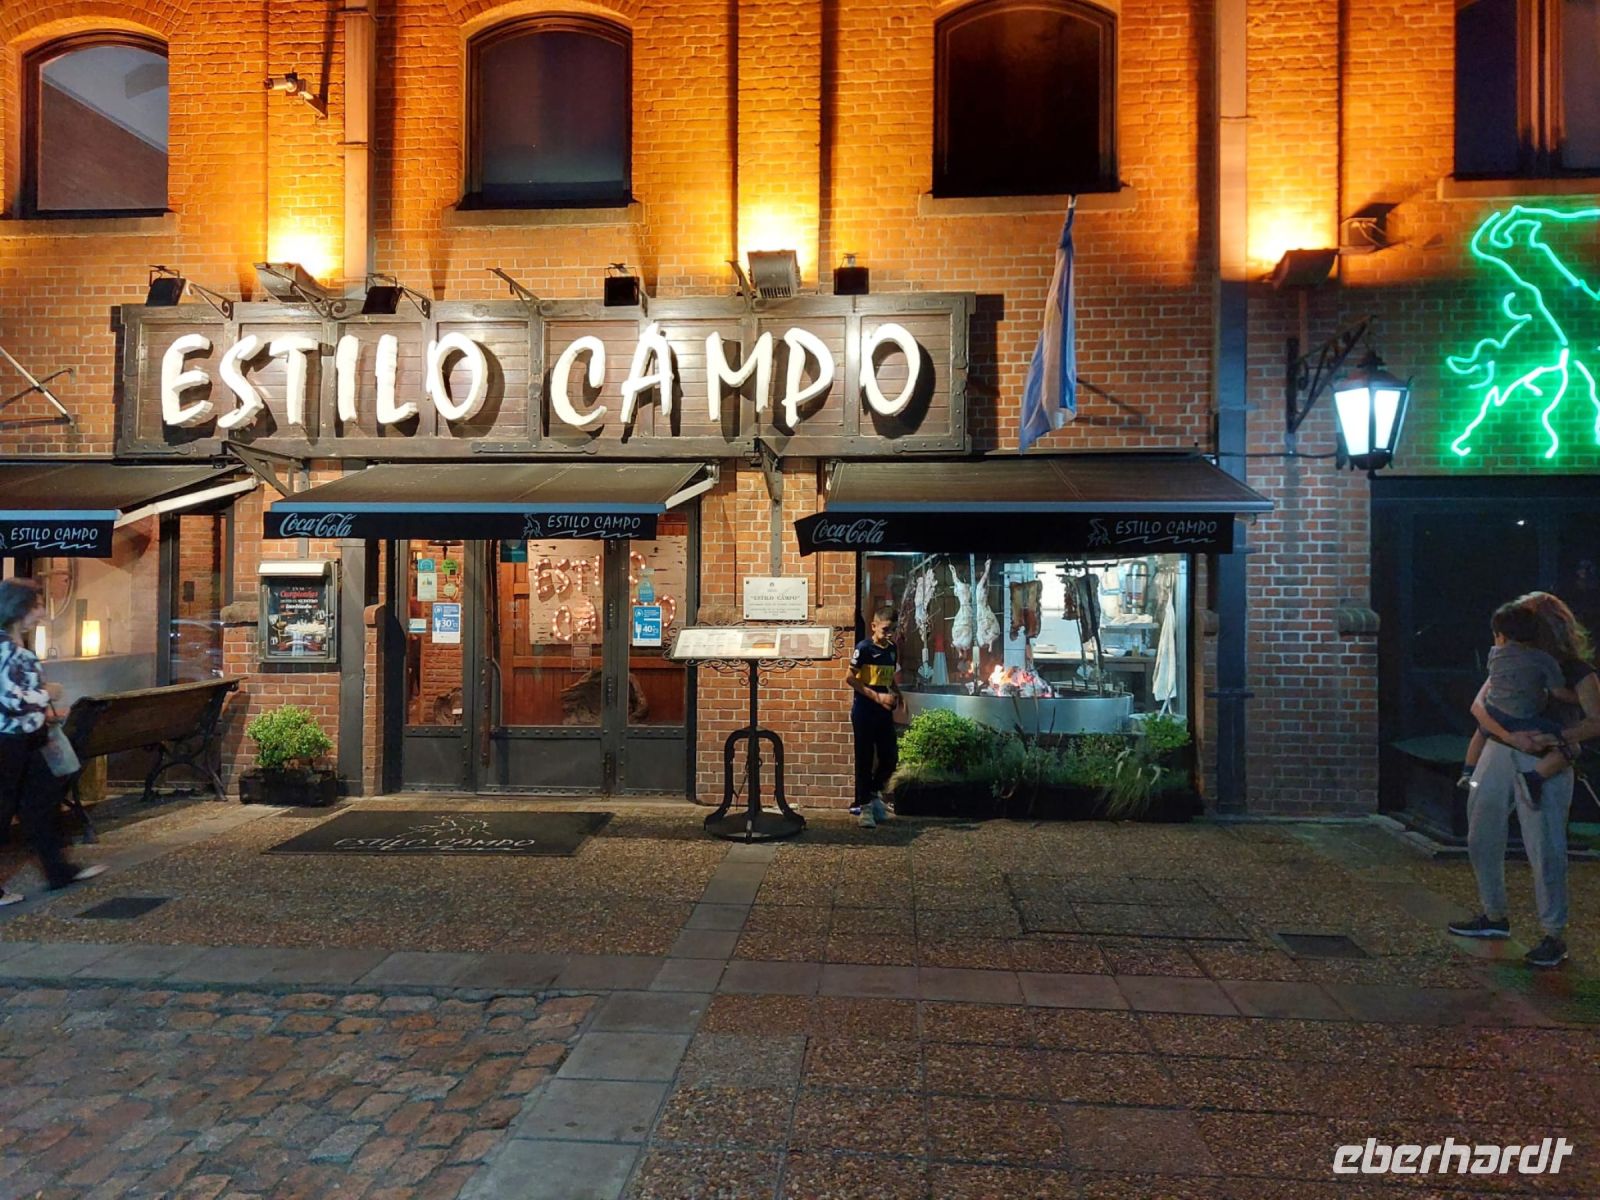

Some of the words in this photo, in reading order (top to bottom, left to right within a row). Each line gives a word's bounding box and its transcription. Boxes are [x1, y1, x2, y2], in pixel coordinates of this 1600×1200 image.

[161, 332, 489, 429] ESTILO
[550, 322, 921, 428] CAMPO
[546, 515, 590, 529] ESTILO
[594, 515, 641, 530] CAMPO
[1115, 520, 1161, 535] ESTILO
[1166, 520, 1217, 535] CAMPO
[11, 527, 51, 541] ESTILO
[54, 527, 98, 541] CAMPO
[333, 838, 427, 849] ESTILO
[433, 838, 536, 848] CAMPO
